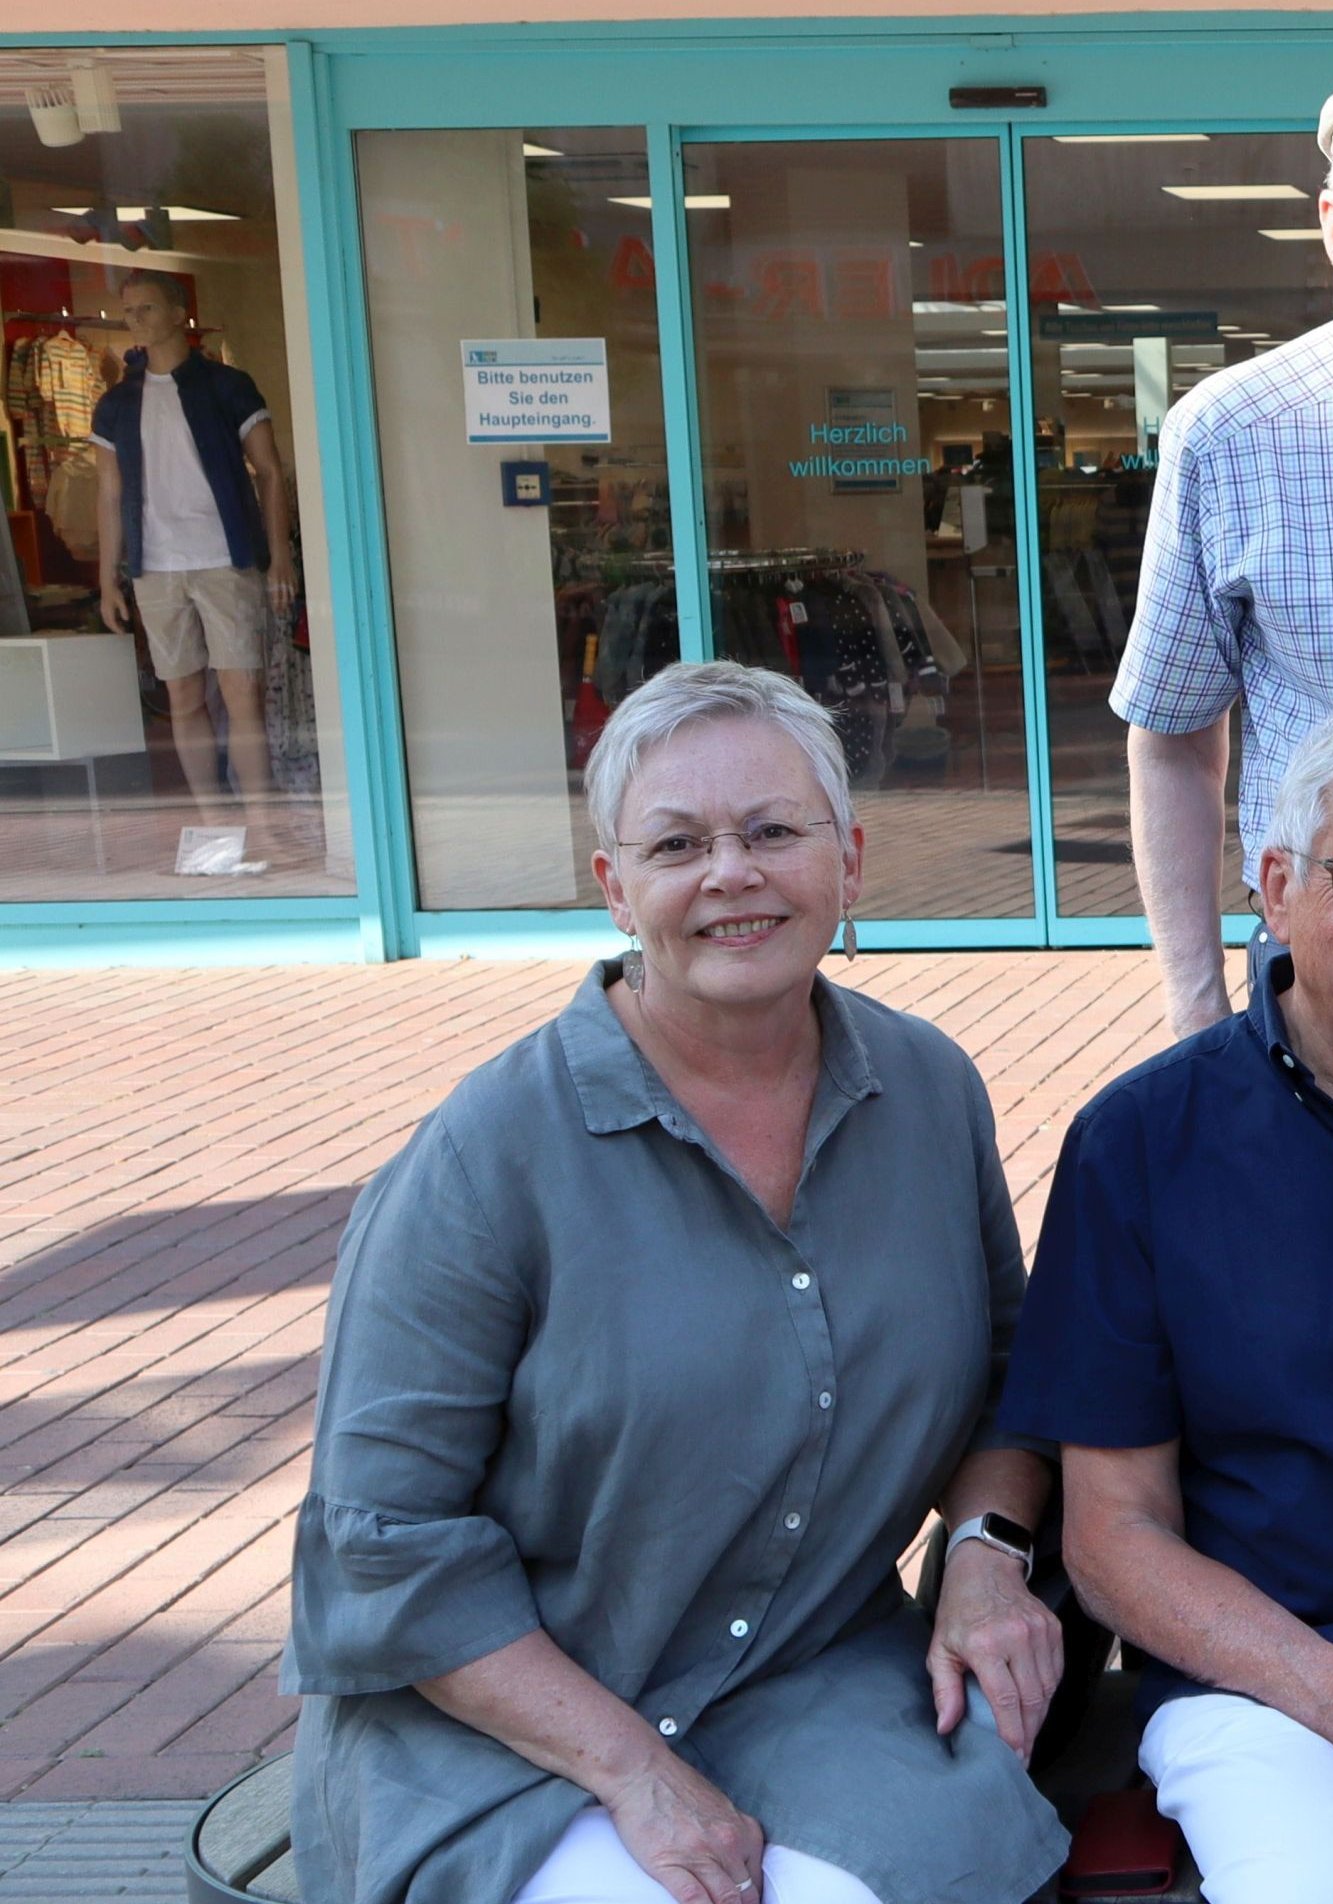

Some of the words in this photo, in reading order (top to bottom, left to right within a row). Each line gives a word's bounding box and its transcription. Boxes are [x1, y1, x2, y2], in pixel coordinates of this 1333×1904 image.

[477, 371, 514, 385] Bitte
[519, 370, 594, 384] benutzen
[508, 391, 534, 405] Sie
[538, 391, 569, 404] den
[479, 412, 597, 428] Haupteingang.
[810, 421, 907, 444] Herzlich
[788, 455, 932, 477] willkommen
